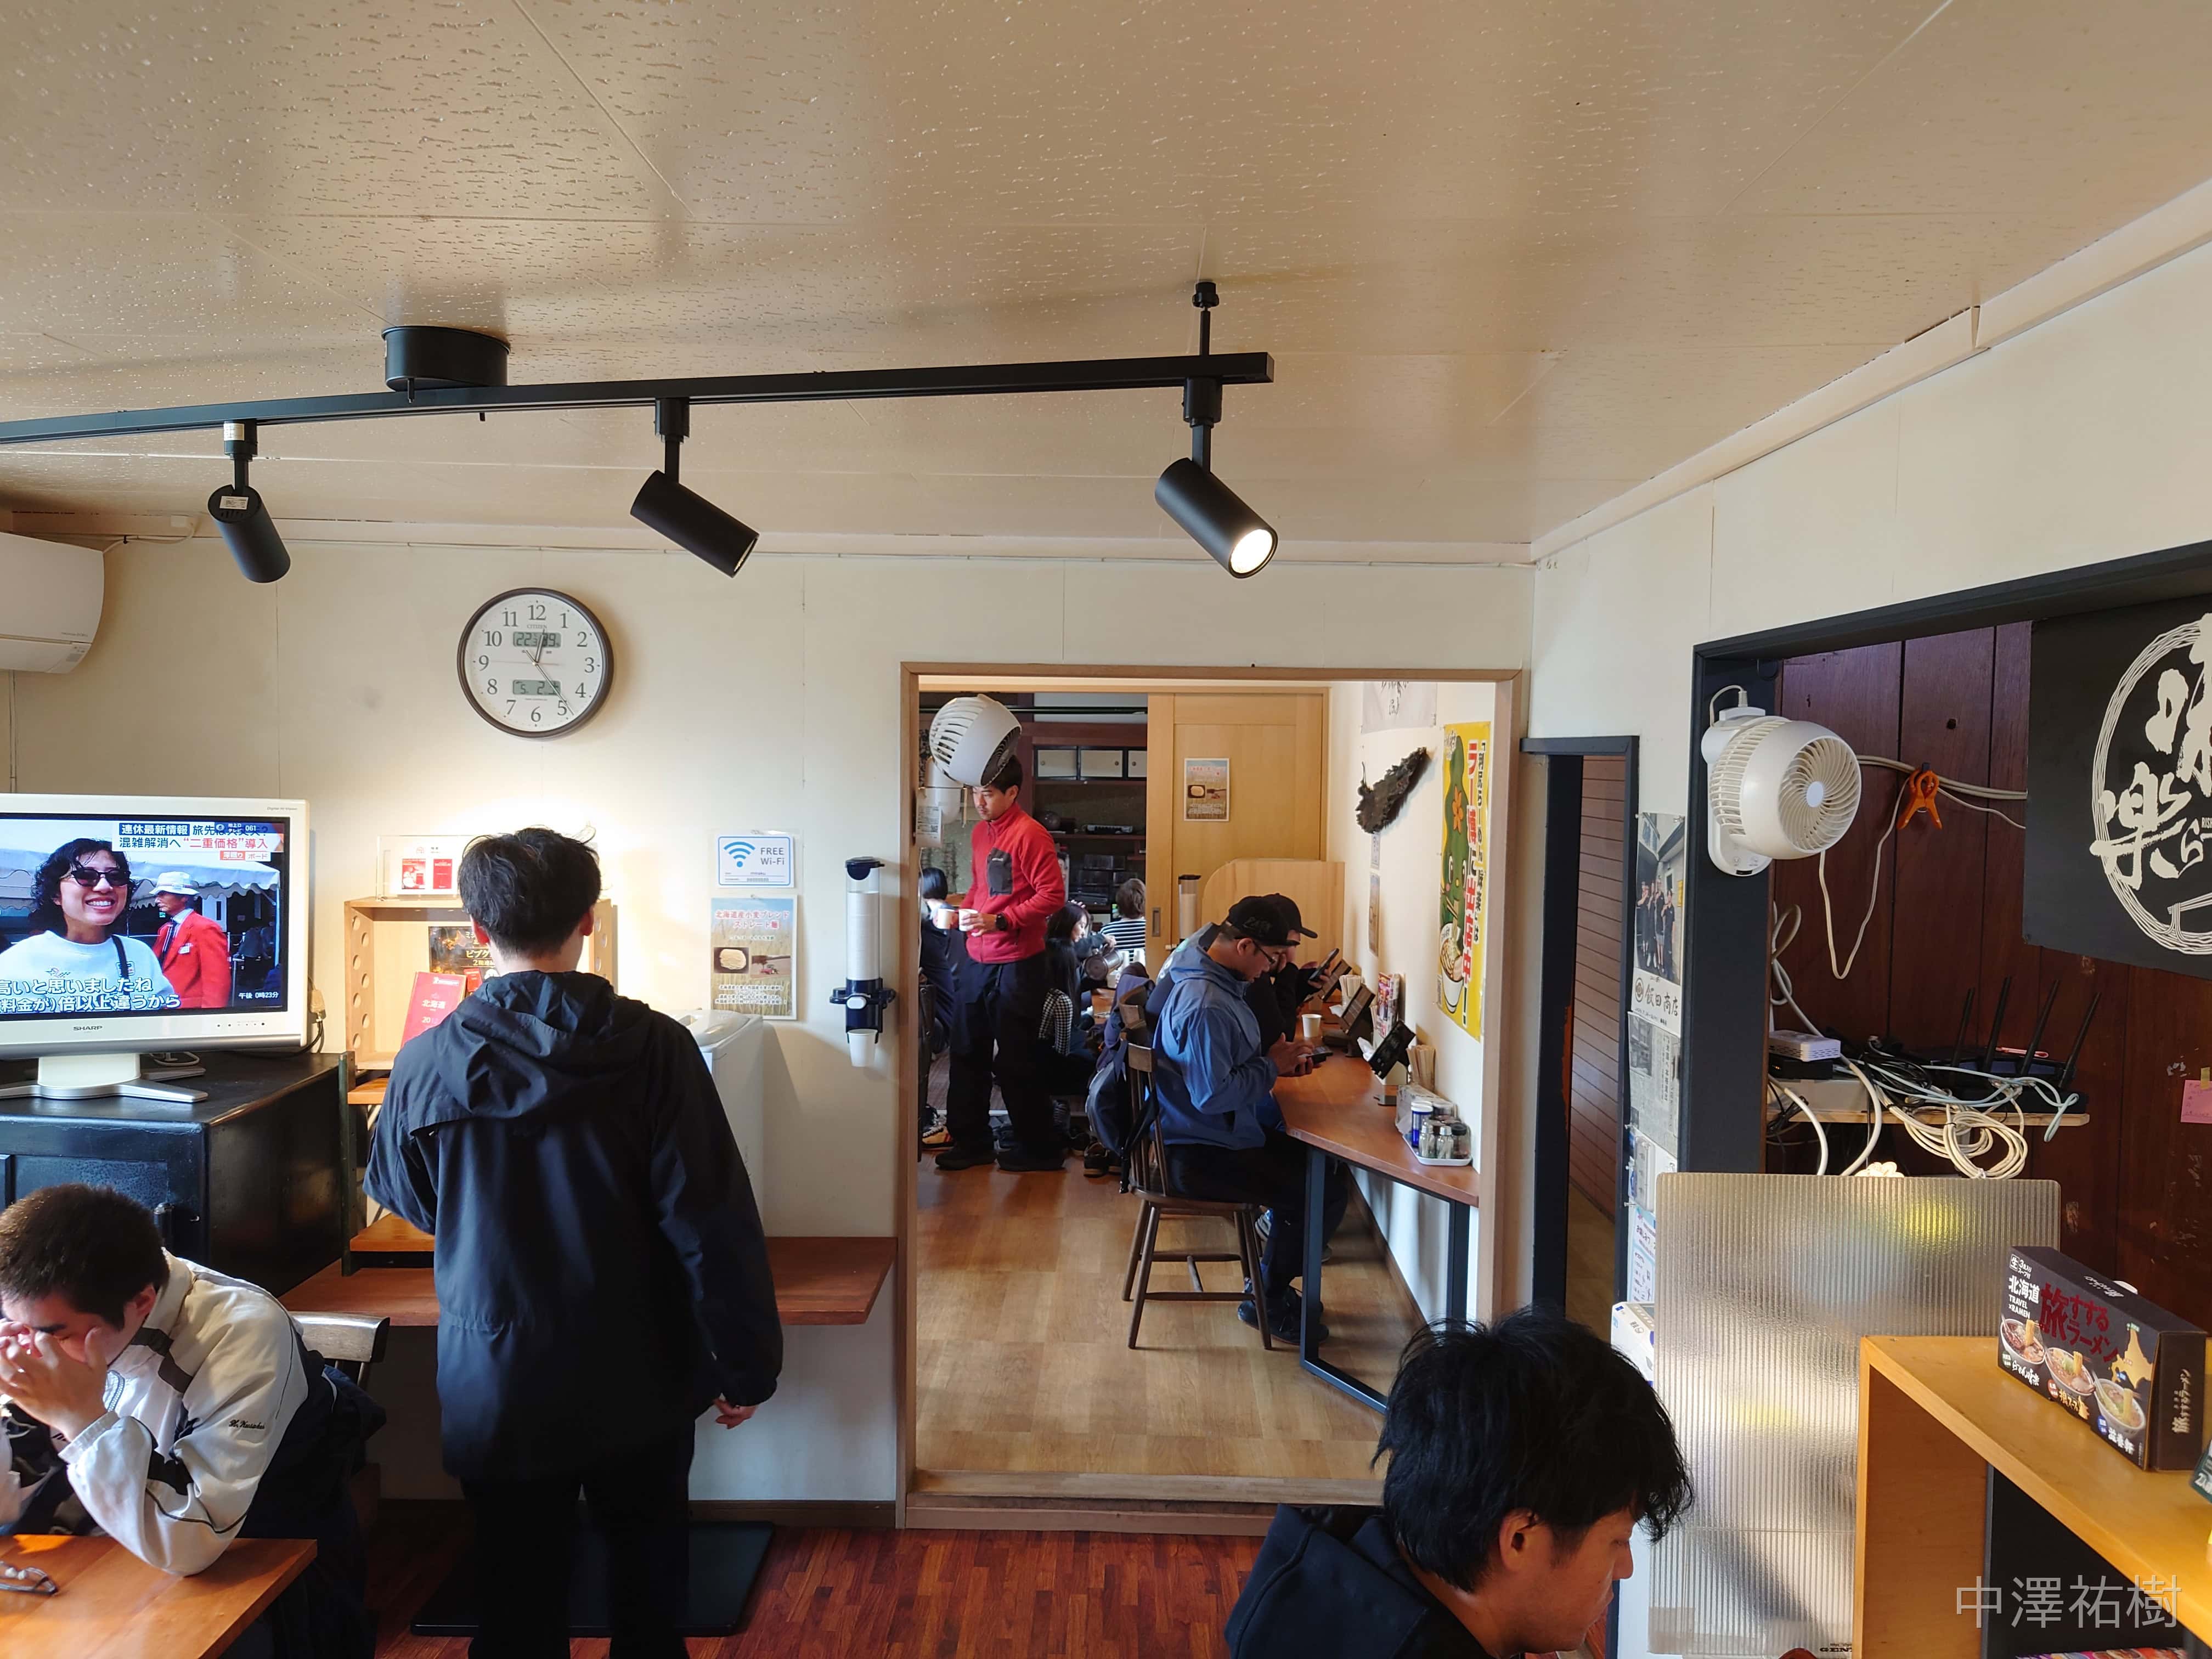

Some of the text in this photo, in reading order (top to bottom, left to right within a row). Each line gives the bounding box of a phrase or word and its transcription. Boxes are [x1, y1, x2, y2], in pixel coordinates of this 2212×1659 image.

[502, 611, 518, 627] 11
[528, 605, 546, 620] 12
[560, 613, 568, 628] 1
[484, 631, 502, 646] 10
[577, 632, 588, 647] 2
[479, 655, 489, 670] 9
[584, 658, 594, 673] 3
[487, 679, 498, 694] 8
[575, 682, 586, 698] 4
[506, 699, 516, 714] 7
[531, 707, 541, 721] 6
[557, 700, 567, 715] 5
[121, 825, 189, 836] 連休最新情報
[760, 847, 785, 855] FREE
[0, 978, 153, 996] 高いと思いましたね
[1645, 983, 1678, 1016] 飯田商店
[2010, 1256, 2018, 1270] 生
[2008, 1274, 2040, 1304] 北海道
[2008, 1294, 2028, 1309] TRAVEL
[2040, 1282, 2110, 1341] 旅する
[2067, 1319, 2119, 1363] ラーメン
